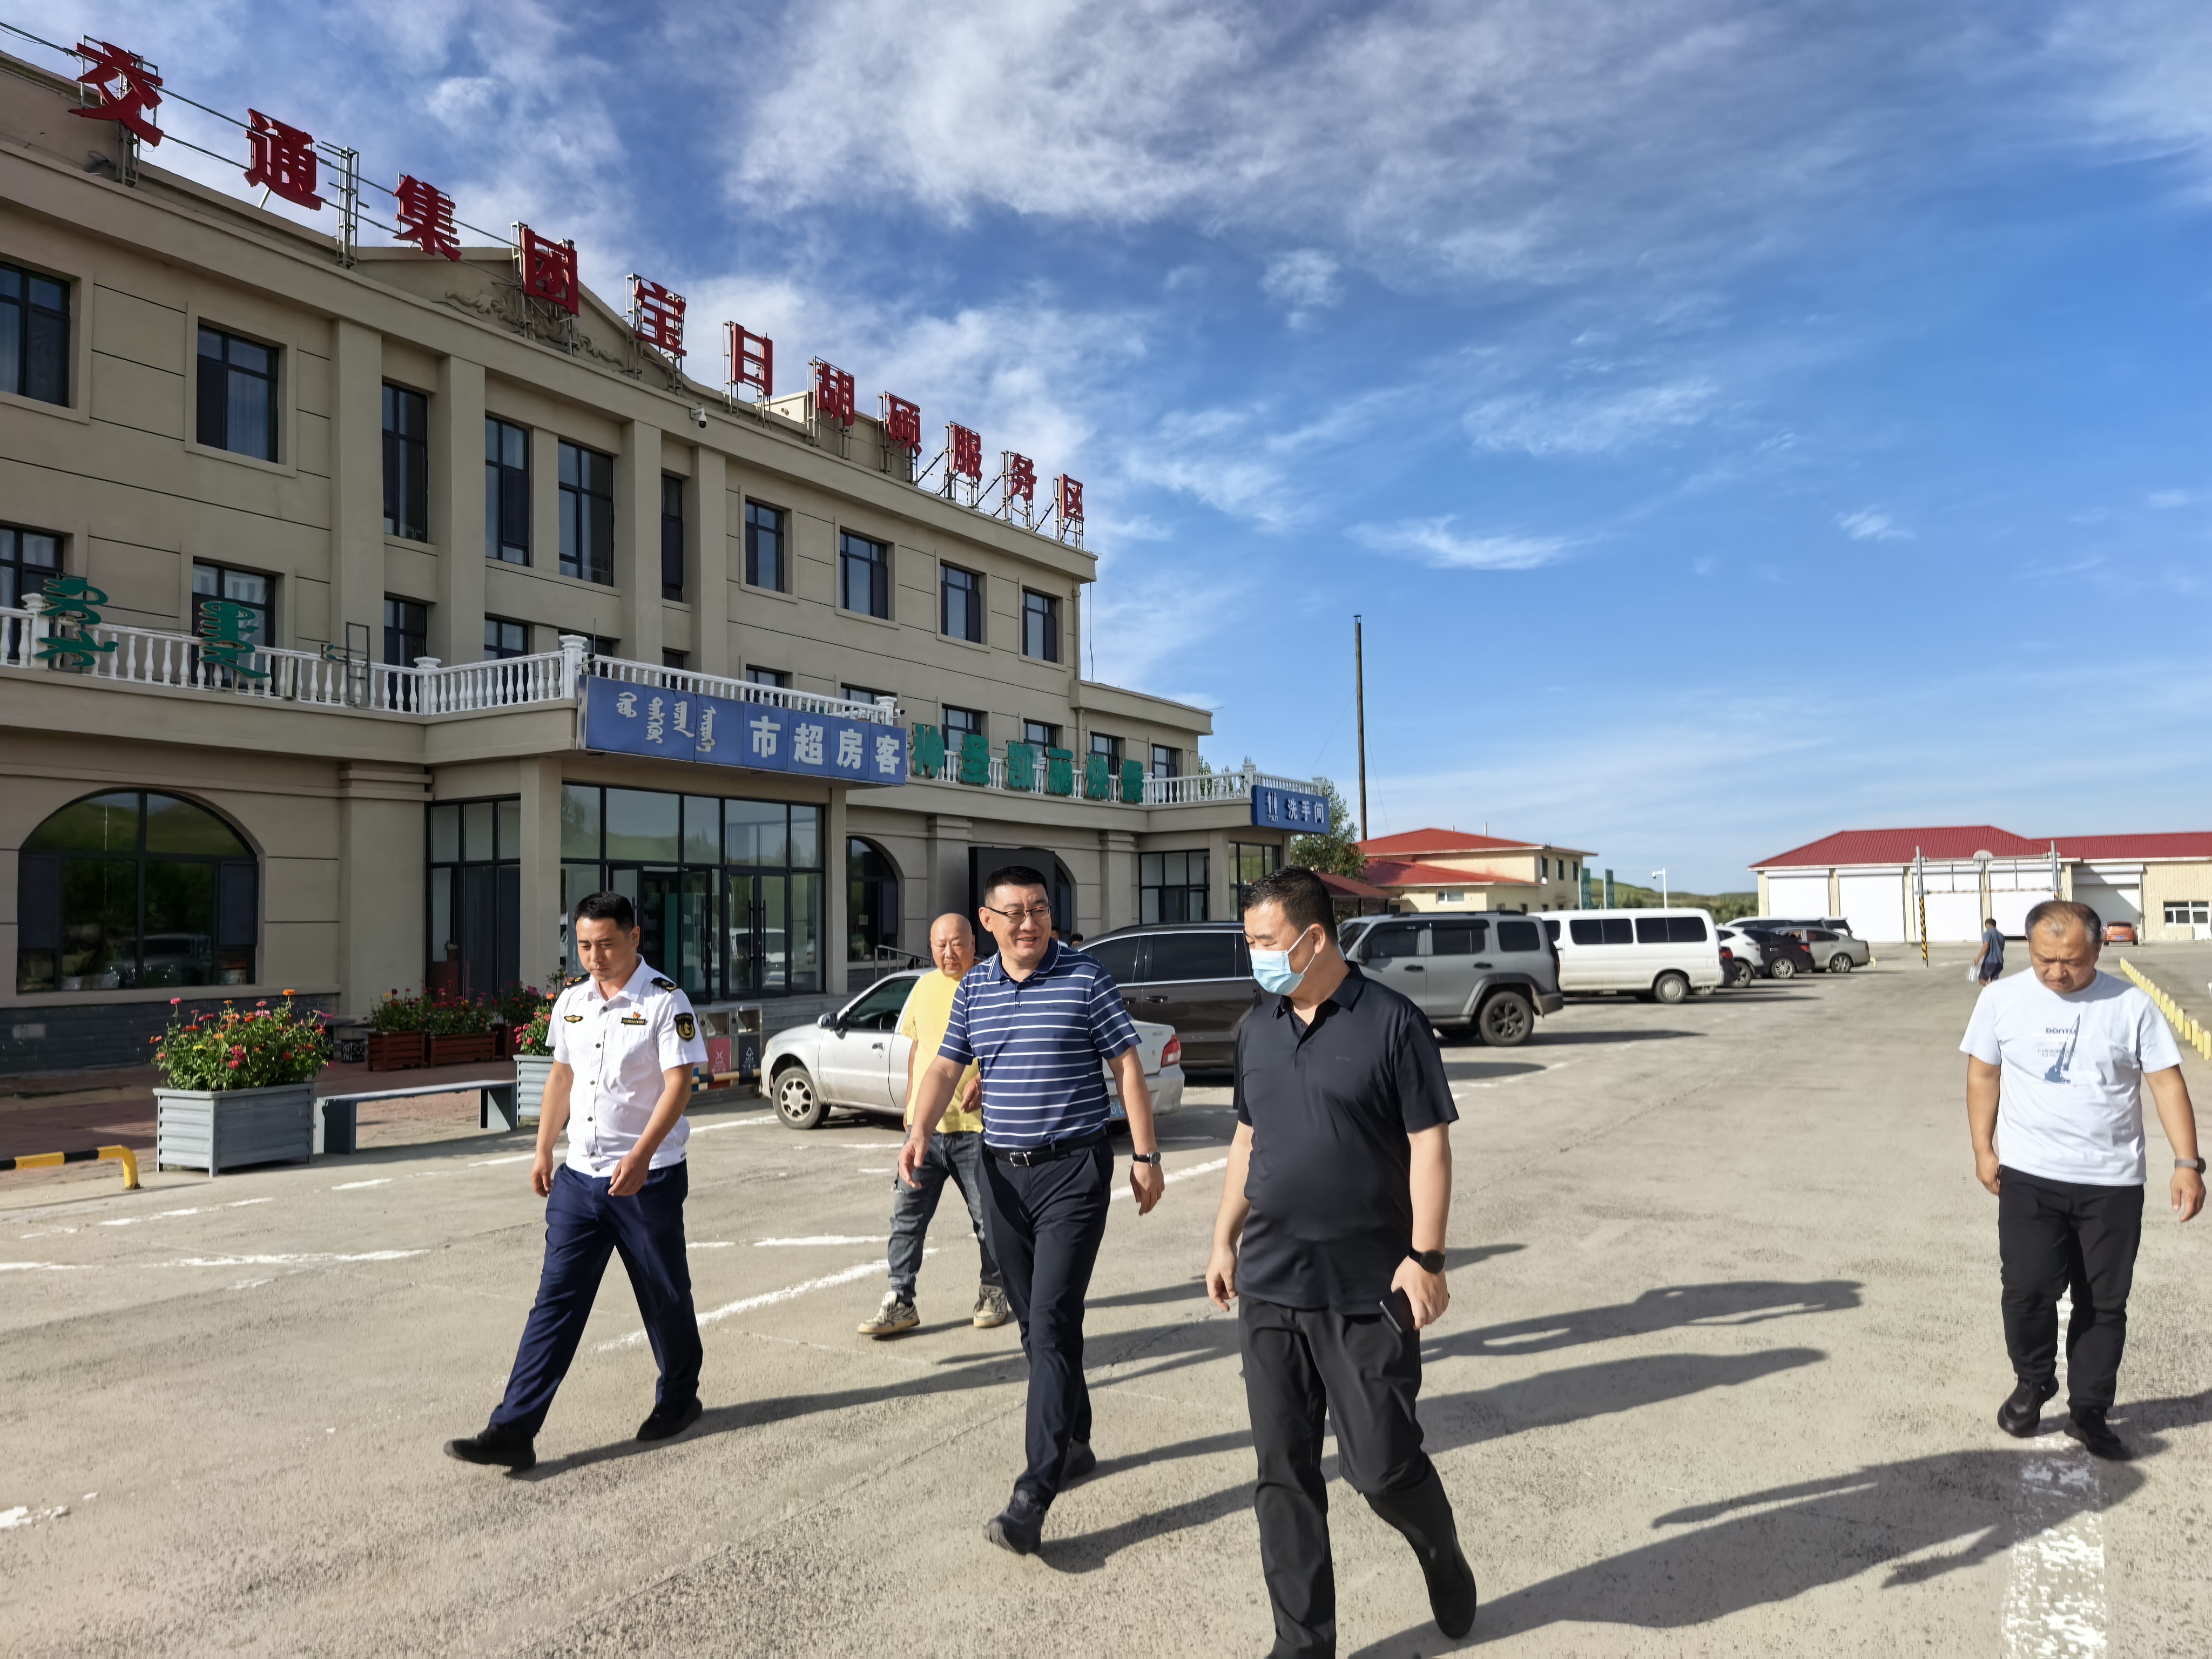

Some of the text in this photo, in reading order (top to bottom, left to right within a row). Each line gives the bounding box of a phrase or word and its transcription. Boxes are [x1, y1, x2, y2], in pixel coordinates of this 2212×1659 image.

[69, 42, 1084, 522] 交通集团宝日胡硕服务区
[1288, 798, 1324, 824] 洗手间
